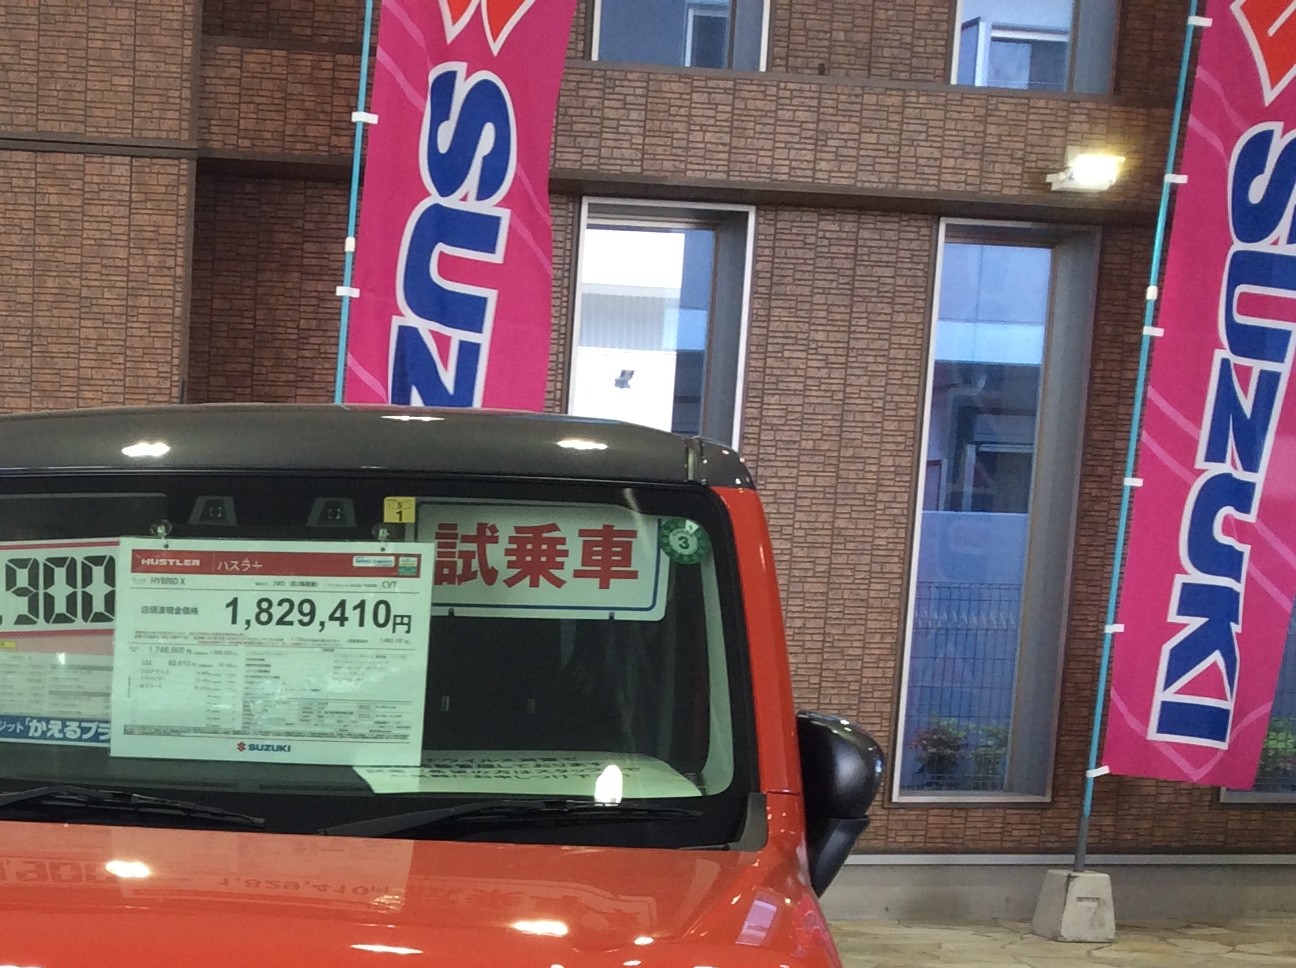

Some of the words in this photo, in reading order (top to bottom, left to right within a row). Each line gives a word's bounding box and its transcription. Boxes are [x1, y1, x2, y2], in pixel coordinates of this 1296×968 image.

[1147, 121, 1296, 750] SUZUKI
[395, 509, 403, 522] 1
[678, 535, 690, 550] 3
[141, 558, 201, 567] HUSTLER
[434, 522, 639, 590] 試乗車
[217, 558, 263, 572] ハスラー
[248, 743, 291, 753] SUZUKI
